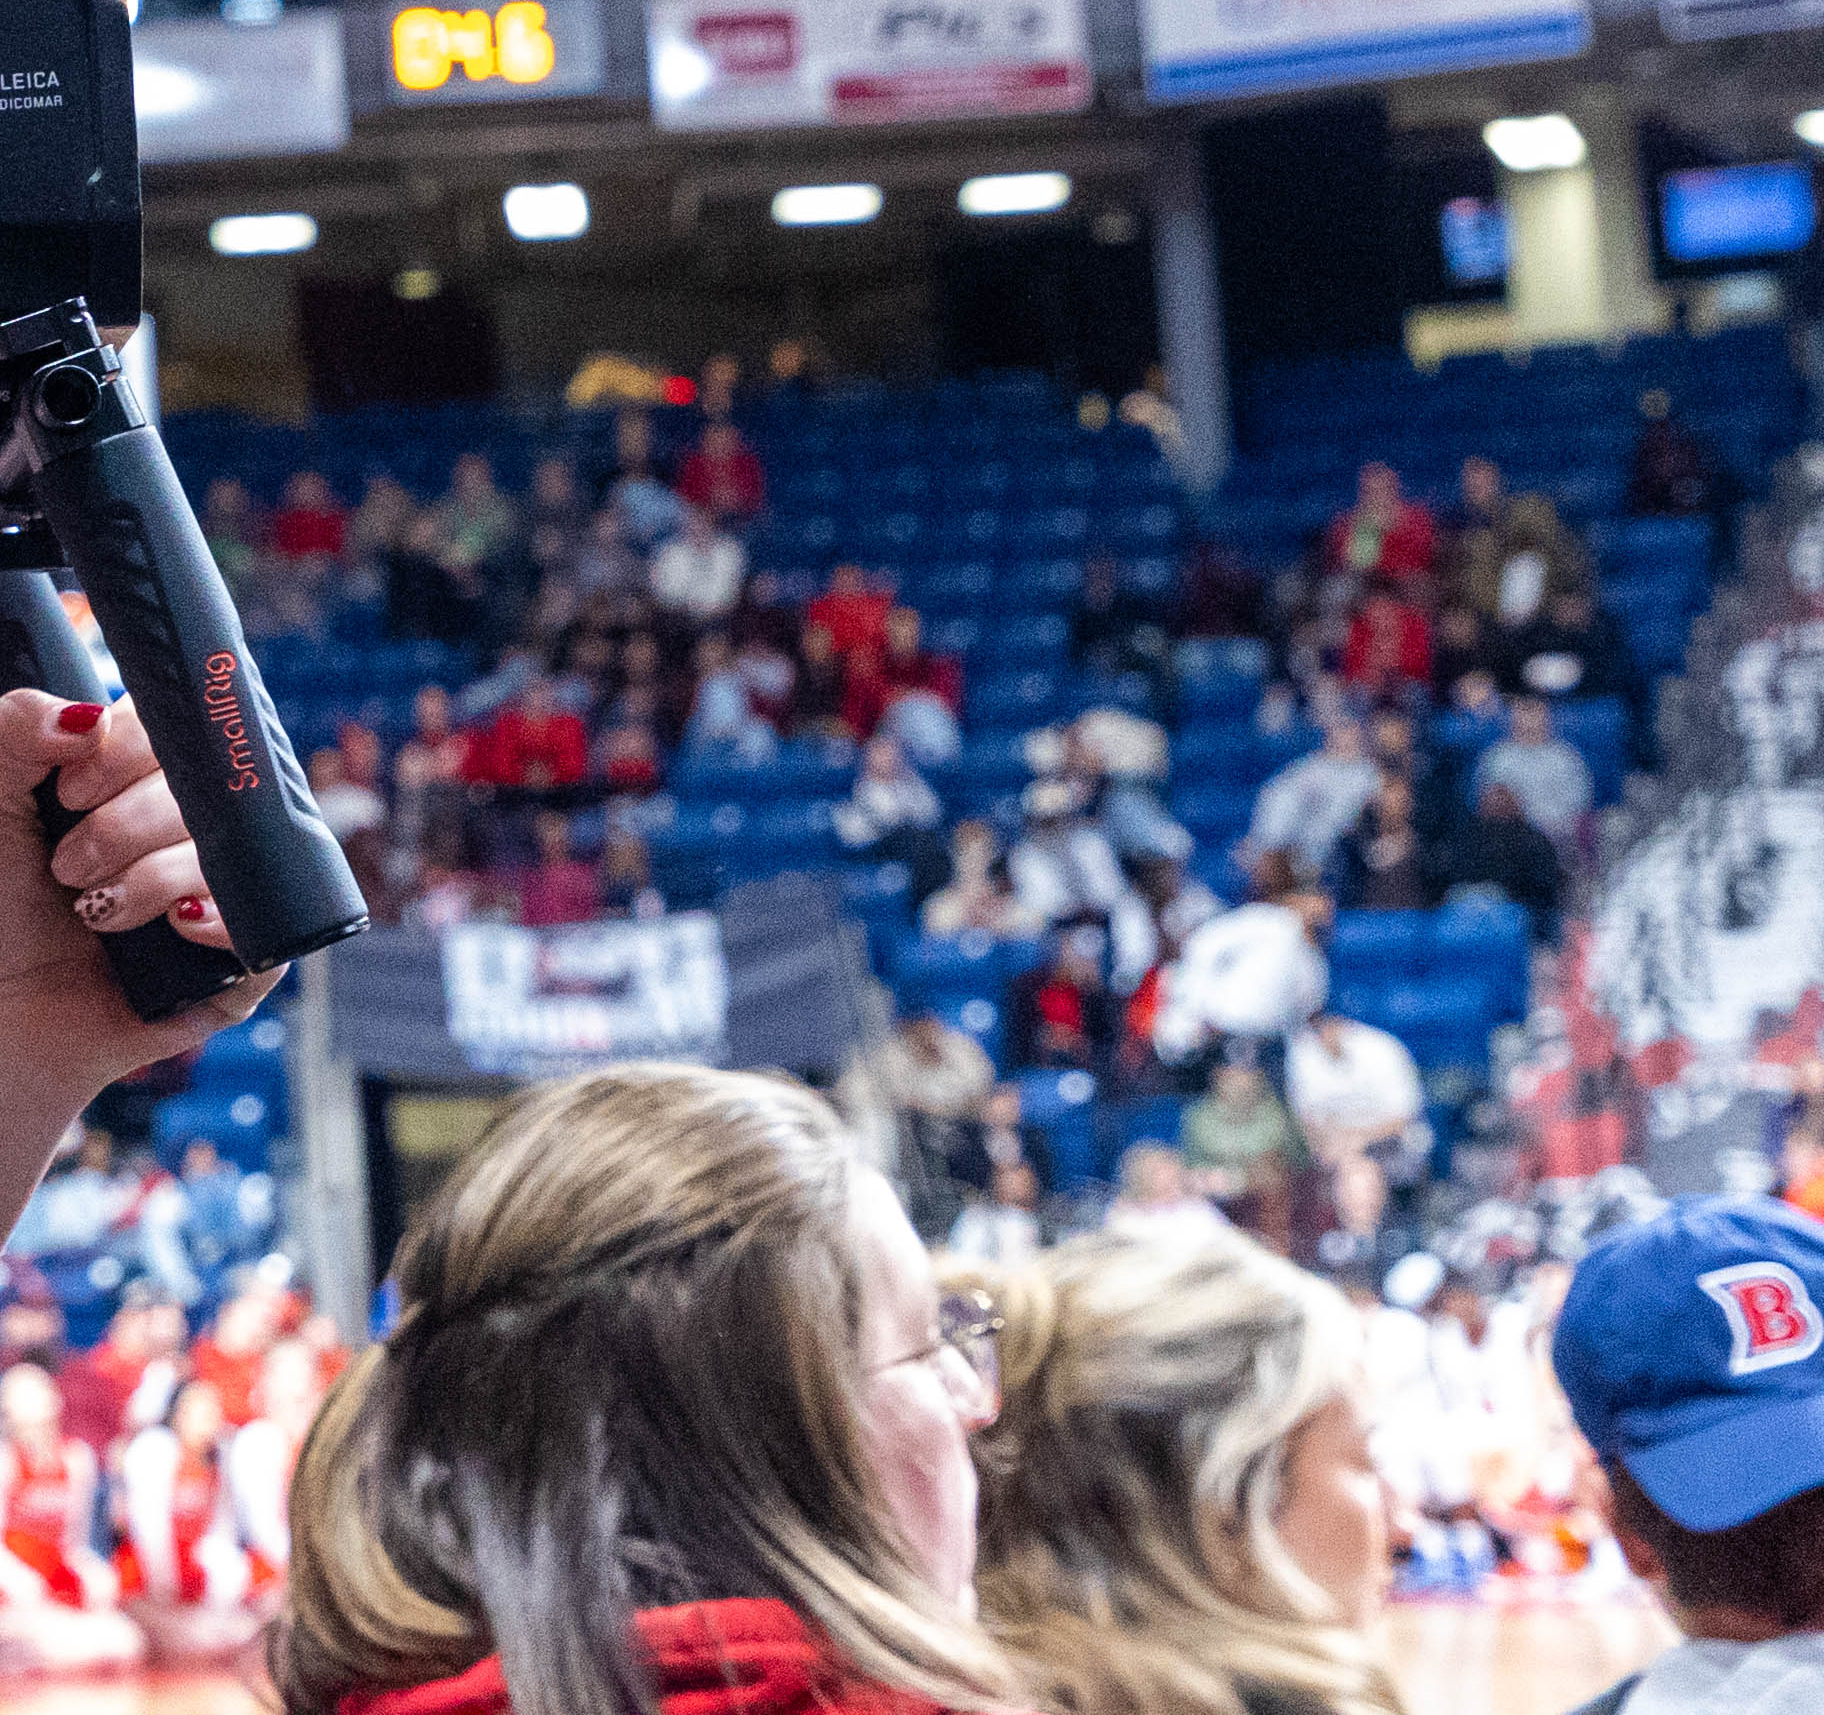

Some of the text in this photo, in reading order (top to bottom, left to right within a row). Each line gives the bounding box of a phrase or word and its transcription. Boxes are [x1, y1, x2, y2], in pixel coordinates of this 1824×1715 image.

[0, 70, 60, 90] LEICA
[0, 94, 63, 111] DICOMAR
[204, 650, 260, 792] SmallRig
[1697, 1260, 1823, 1376] B
